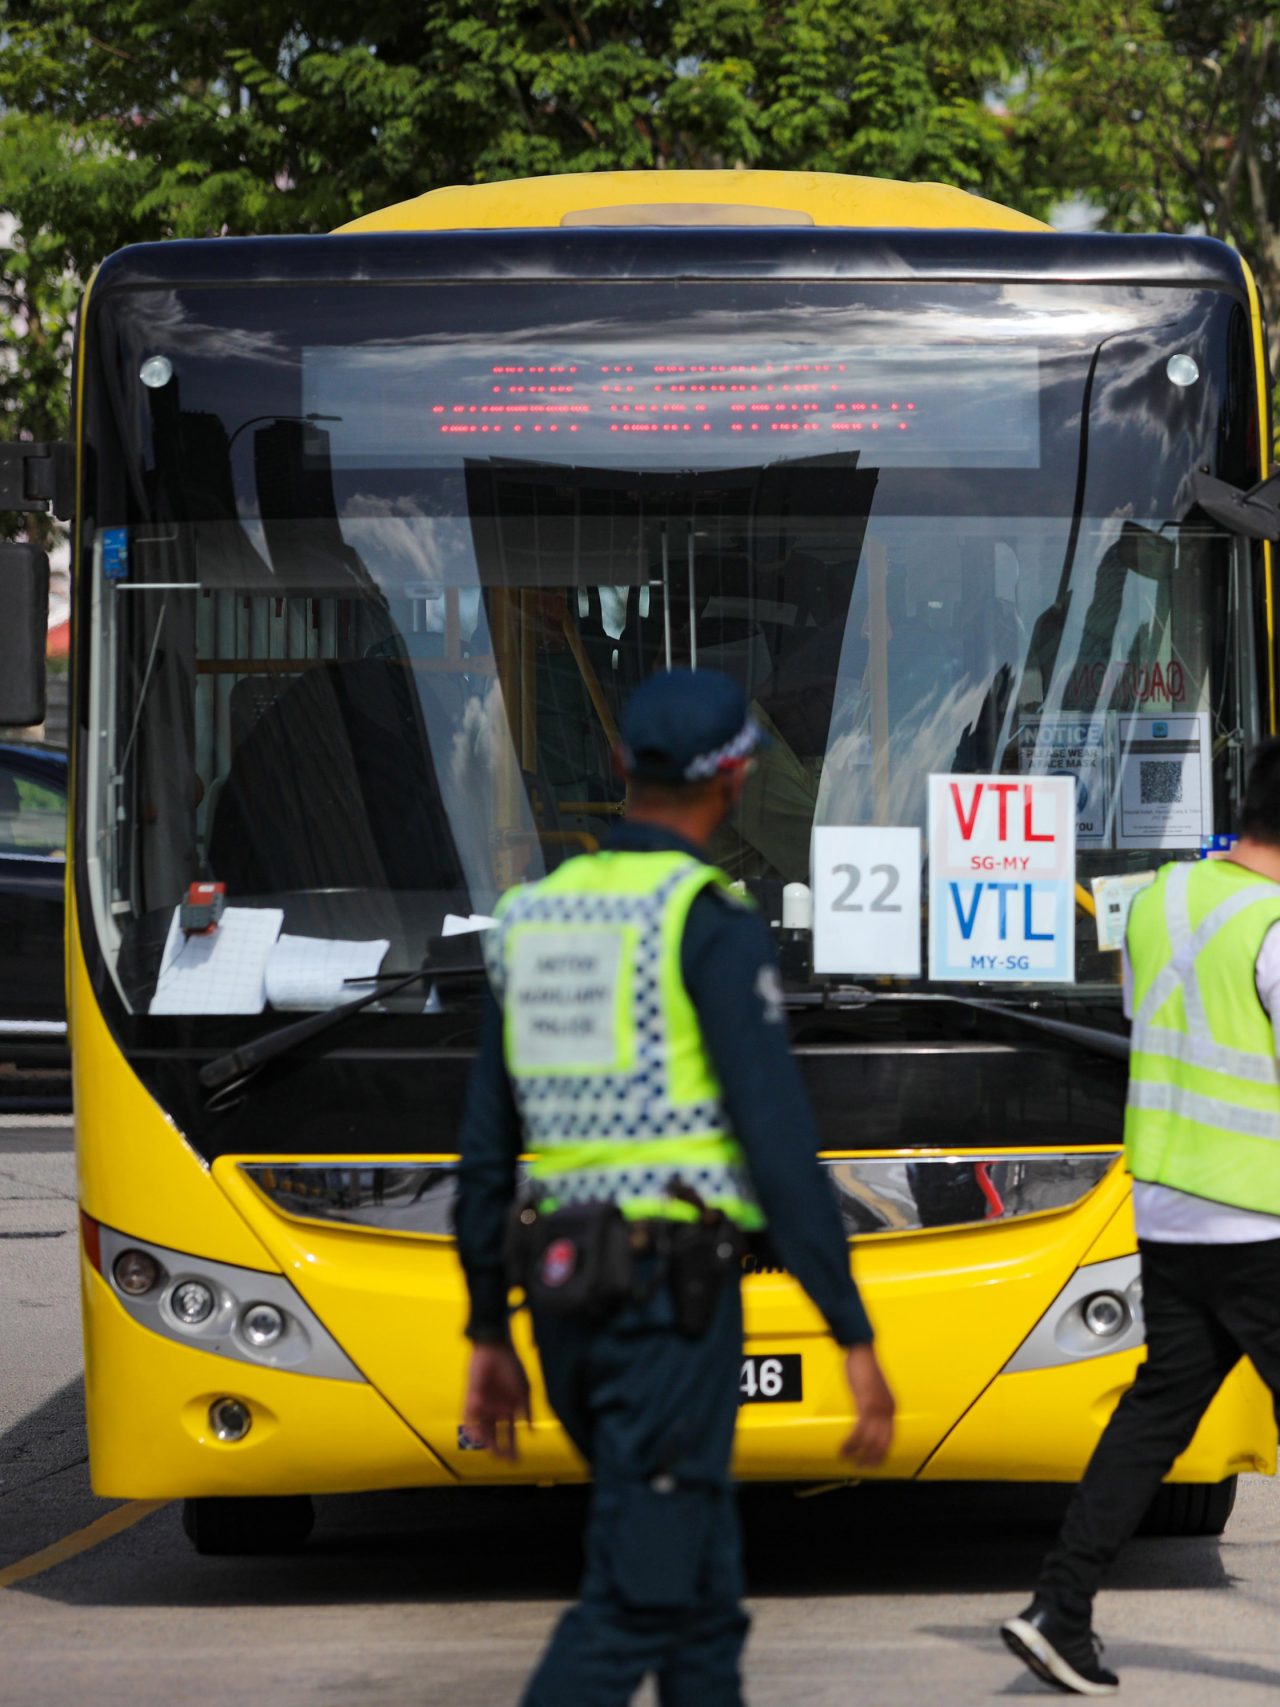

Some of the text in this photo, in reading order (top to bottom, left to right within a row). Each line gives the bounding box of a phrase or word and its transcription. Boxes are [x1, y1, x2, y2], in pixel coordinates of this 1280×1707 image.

[1024, 727, 1101, 743] NOTICE
[1066, 759, 1097, 768] MASK
[949, 783, 1055, 842] VTL
[970, 856, 1030, 871] SG-MY
[830, 864, 903, 913] 22
[949, 882, 1055, 941] VTL
[970, 955, 1030, 970] MY-SG
[740, 1359, 783, 1397] 46
